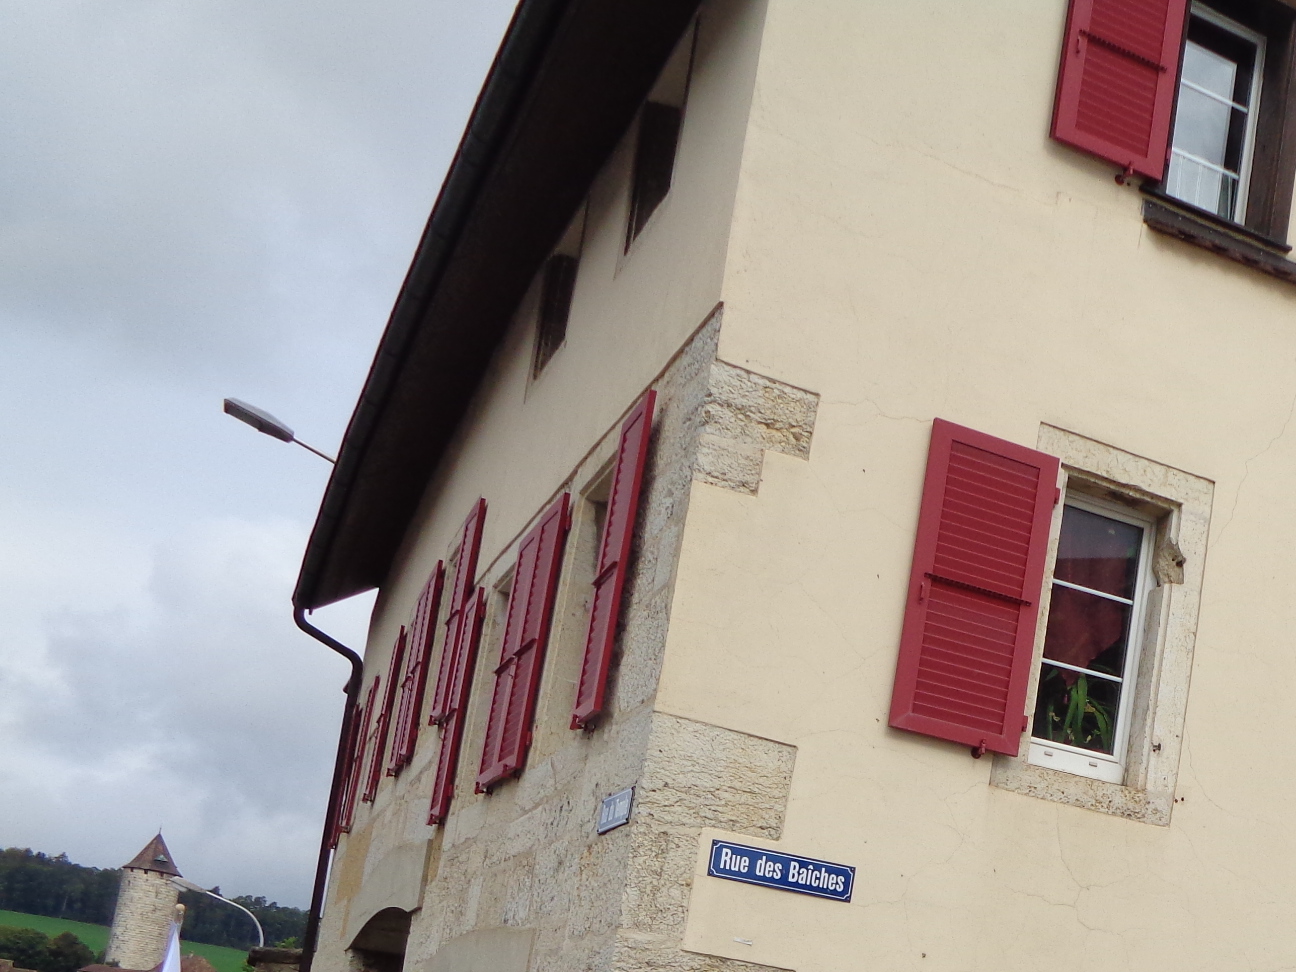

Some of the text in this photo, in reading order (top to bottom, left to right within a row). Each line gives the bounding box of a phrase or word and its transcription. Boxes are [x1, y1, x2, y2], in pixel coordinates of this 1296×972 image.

[720, 848, 845, 892] Rue des Baîches
